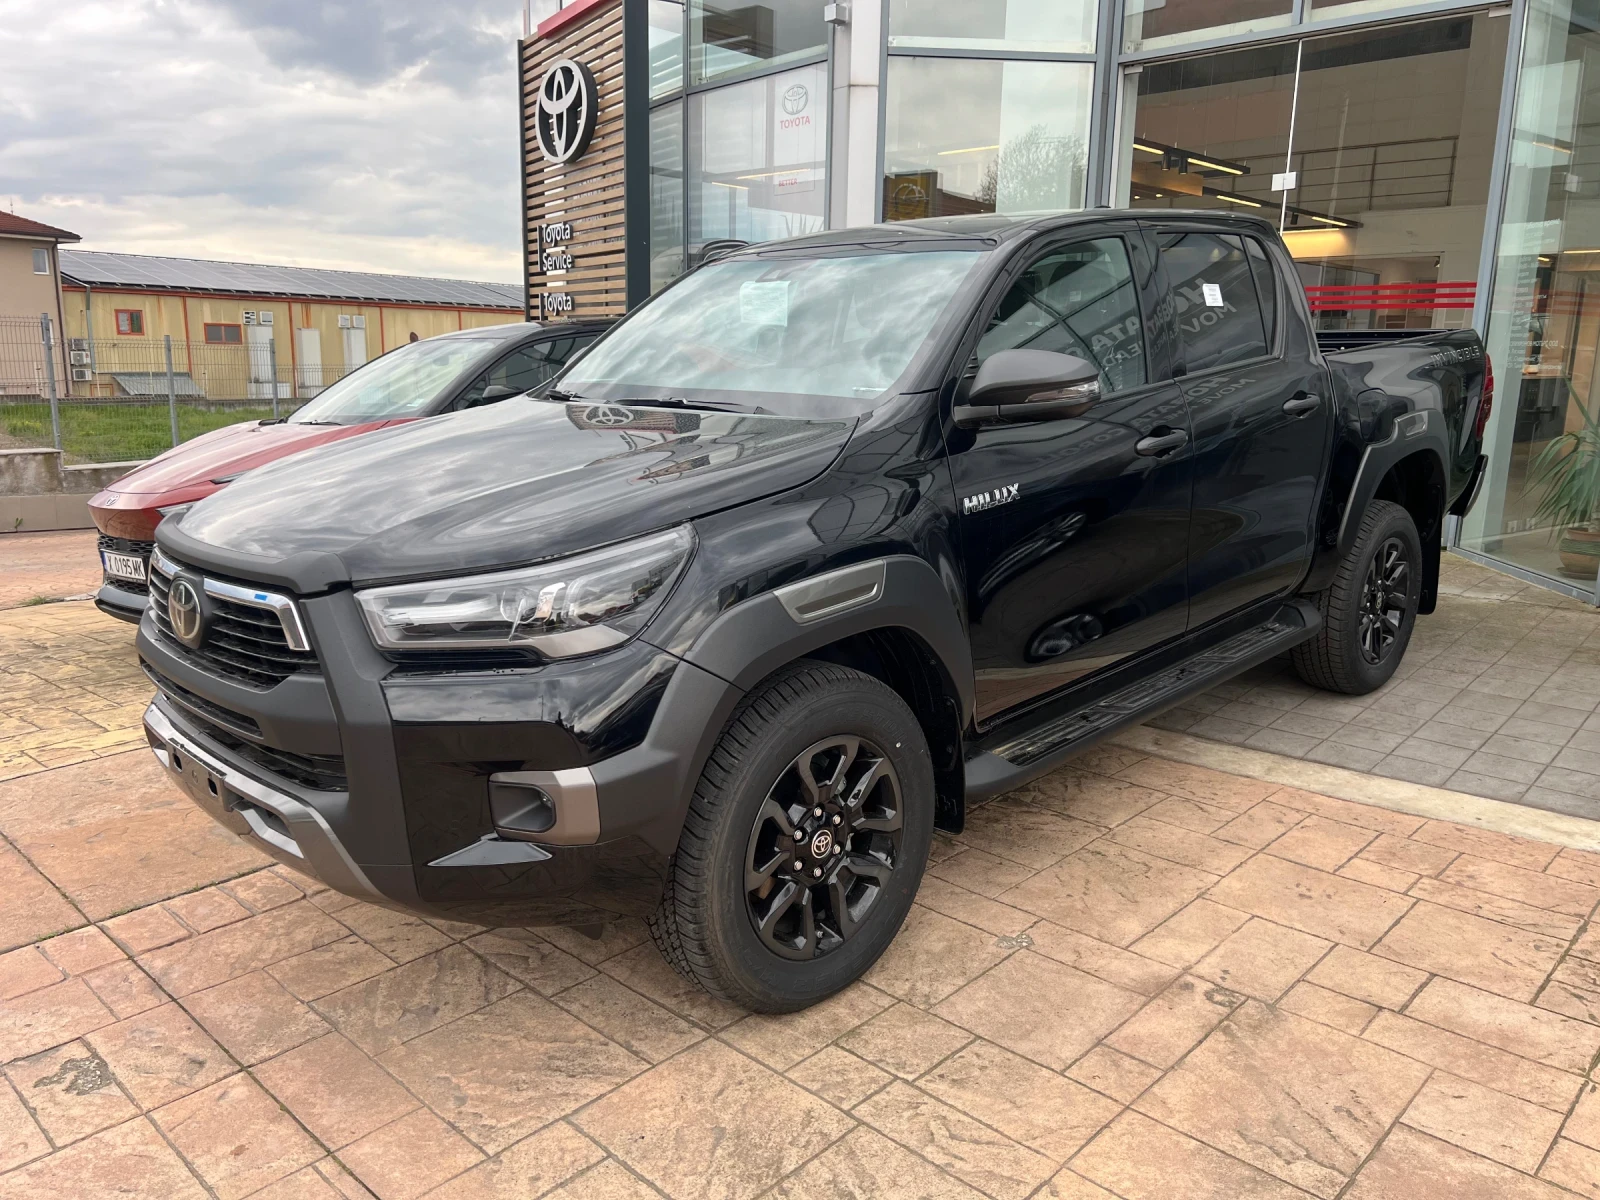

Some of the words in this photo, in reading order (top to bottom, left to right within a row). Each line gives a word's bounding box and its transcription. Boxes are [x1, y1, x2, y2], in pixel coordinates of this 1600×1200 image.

[780, 116, 811, 129] TOYOTA
[542, 222, 571, 247] Toyota
[543, 250, 572, 271] Service
[544, 292, 572, 316] Toyota
[1430, 345, 1480, 368] INVINCIBLE
[963, 482, 1020, 515] HILUX
[115, 557, 132, 575] 0195
